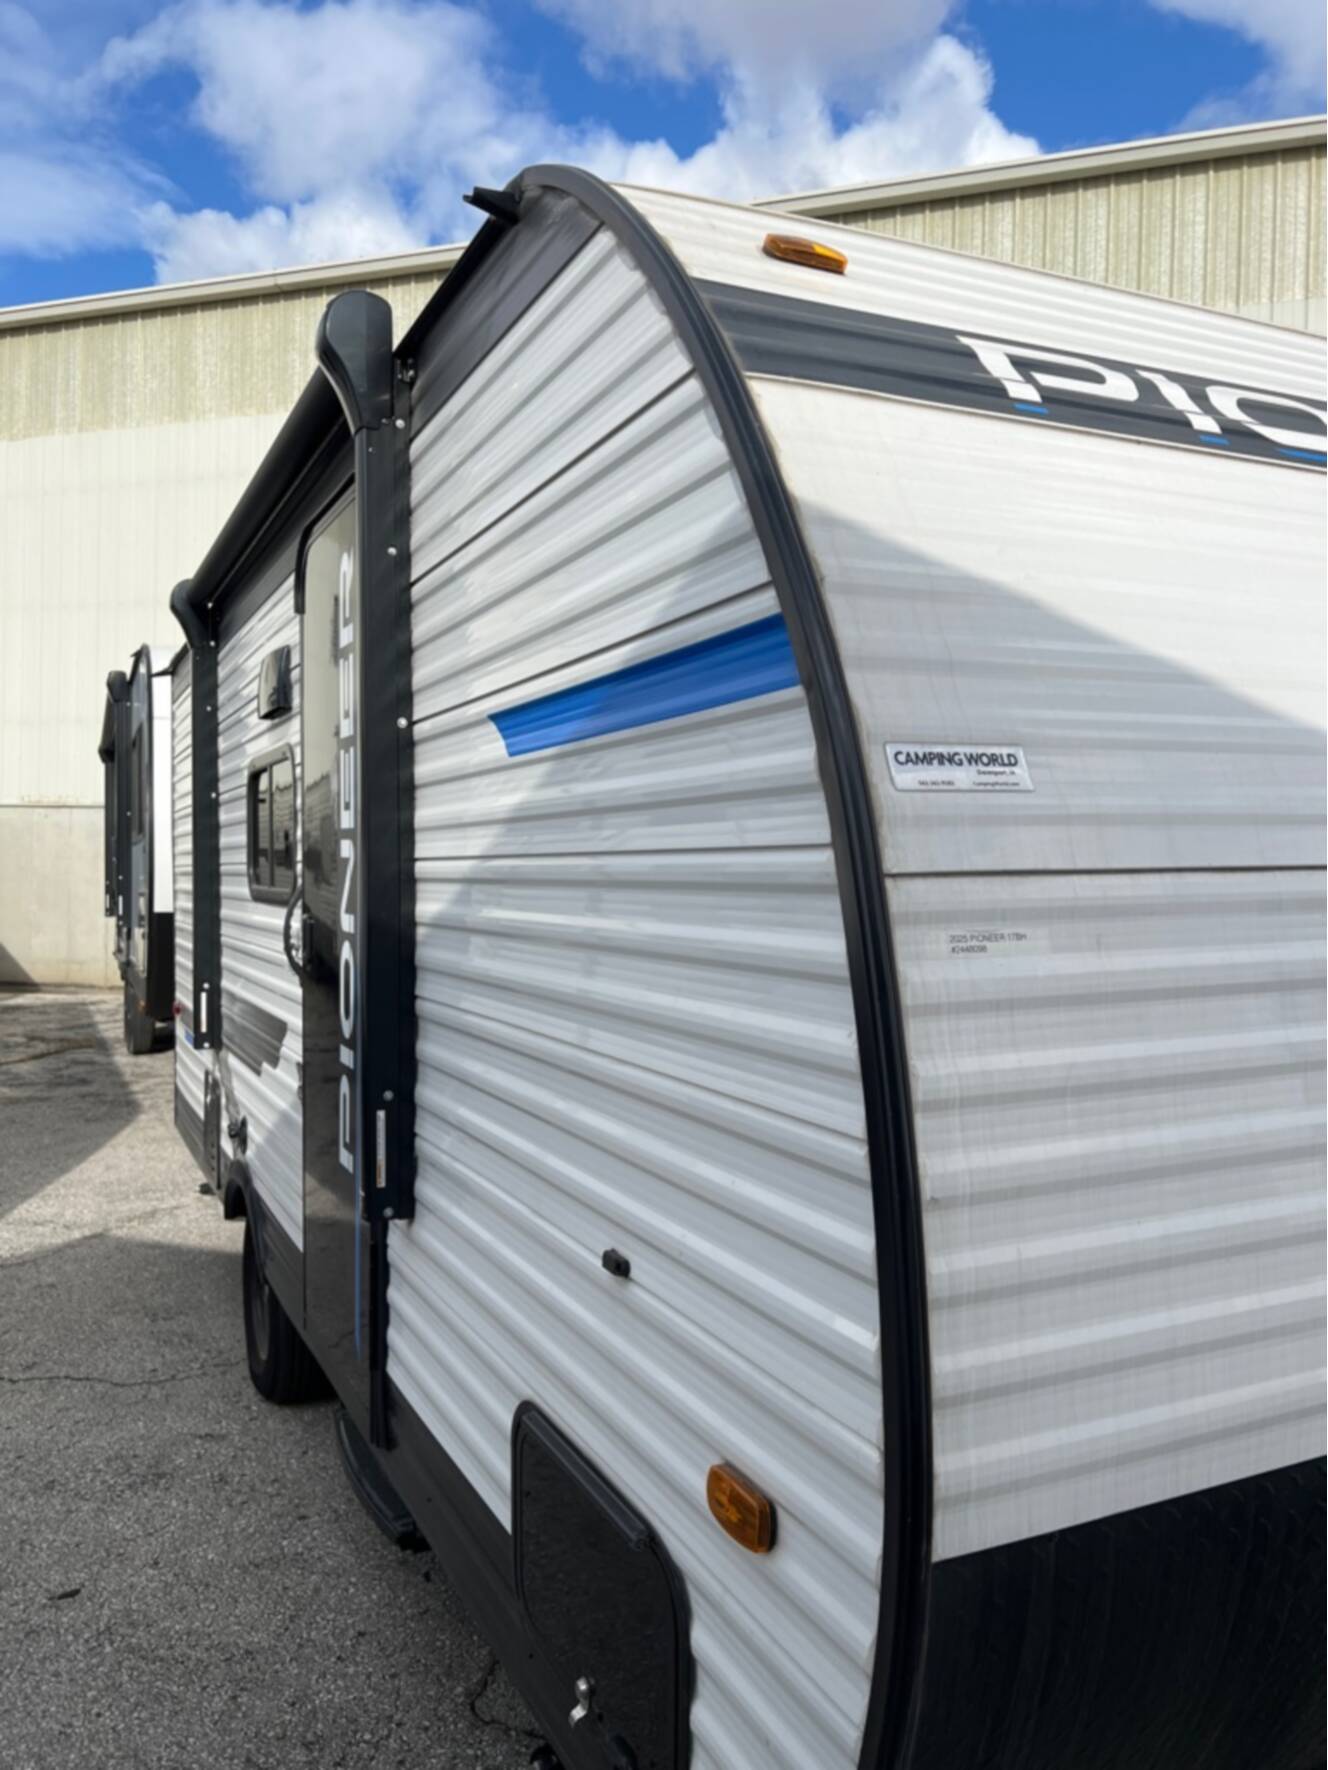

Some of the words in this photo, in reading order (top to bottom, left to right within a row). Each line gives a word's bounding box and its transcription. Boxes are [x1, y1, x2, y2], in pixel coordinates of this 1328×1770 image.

[894, 751, 963, 767] CAMPING
[964, 752, 1019, 767] WORLD
[338, 548, 355, 1173] PIONEER
[950, 933, 968, 943] 2025
[970, 932, 1005, 943] PIONEER
